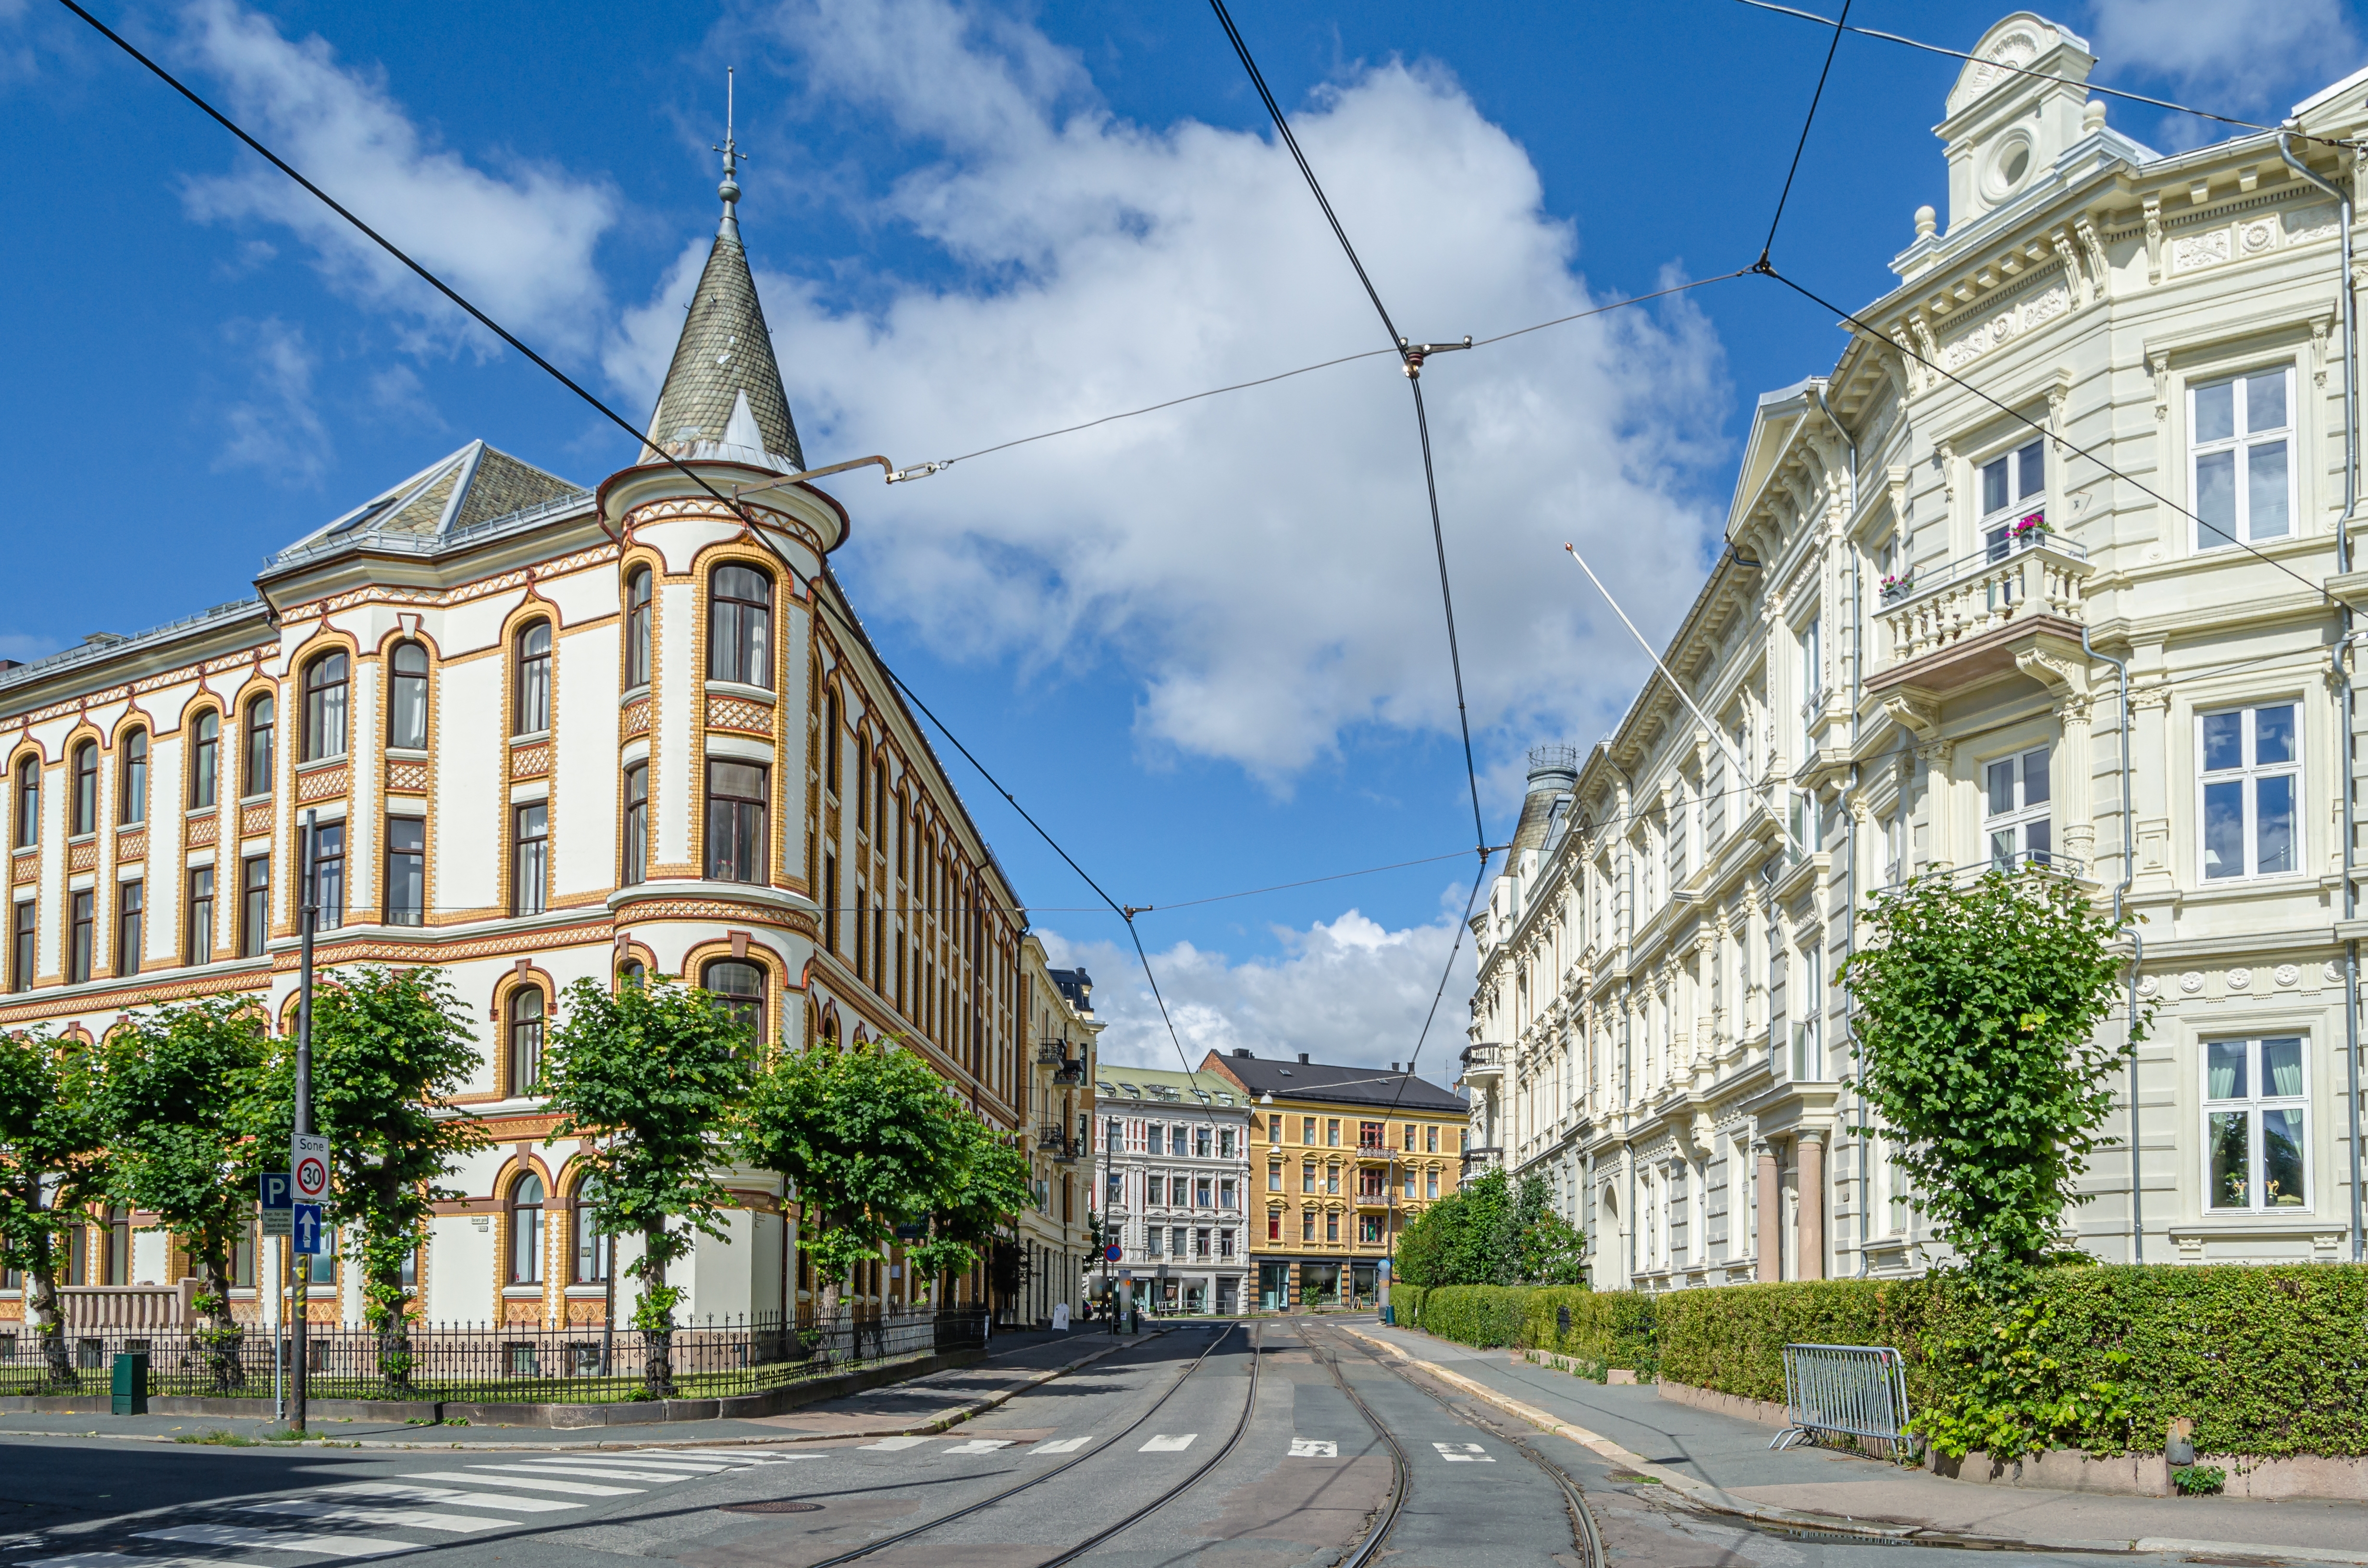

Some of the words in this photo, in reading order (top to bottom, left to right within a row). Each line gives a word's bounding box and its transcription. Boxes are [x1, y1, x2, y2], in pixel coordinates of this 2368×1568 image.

[300, 1138, 324, 1152] Sone
[303, 1166, 321, 1186] 30
[269, 1178, 285, 1204] P
